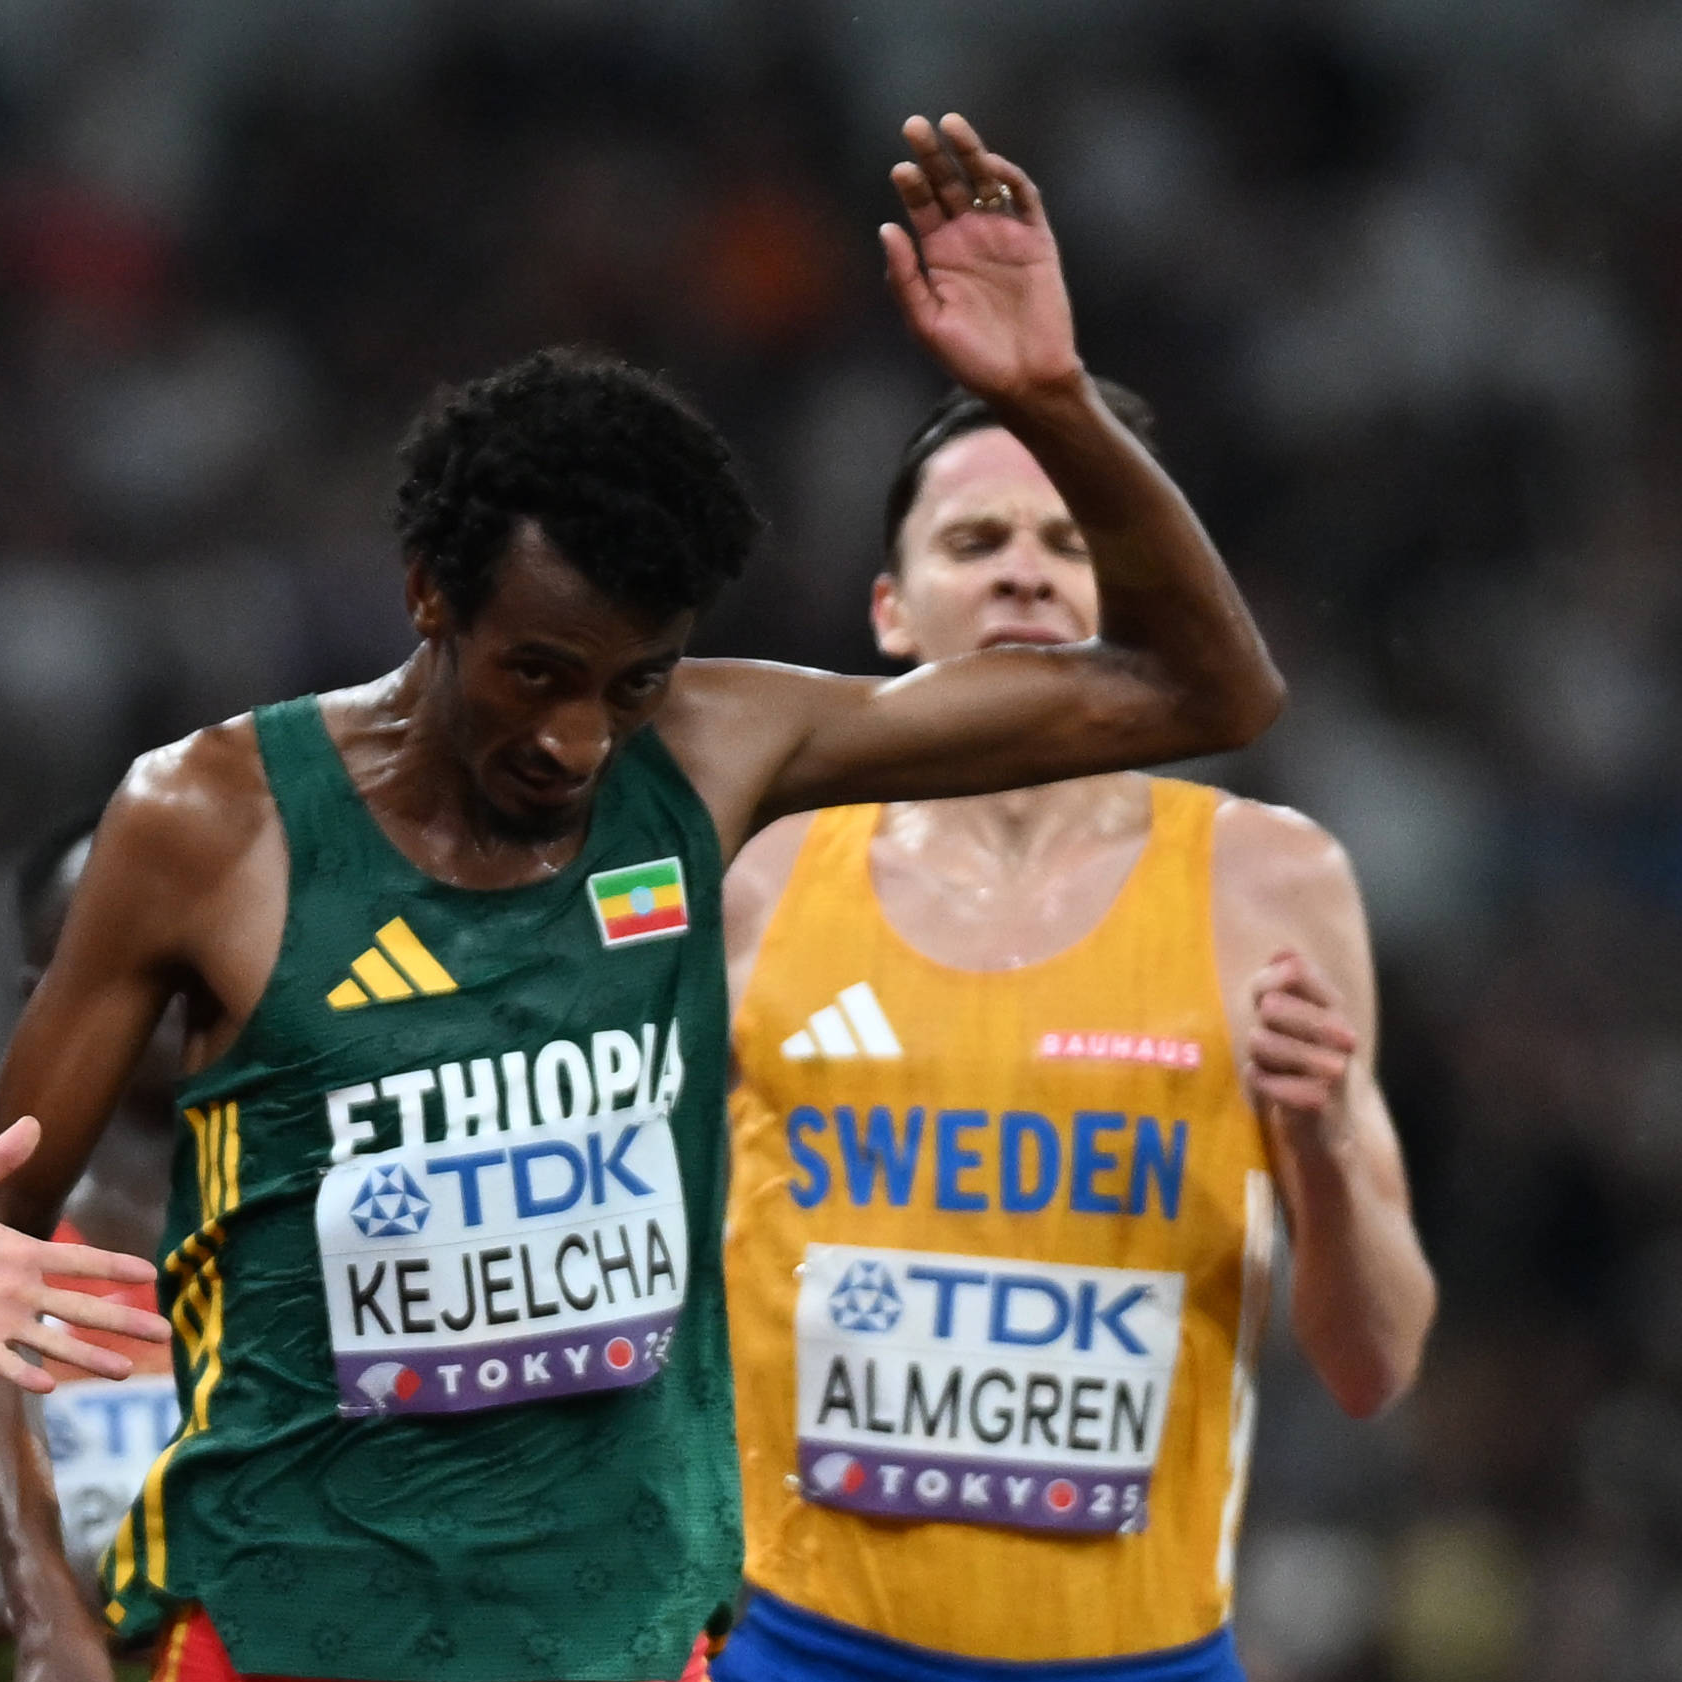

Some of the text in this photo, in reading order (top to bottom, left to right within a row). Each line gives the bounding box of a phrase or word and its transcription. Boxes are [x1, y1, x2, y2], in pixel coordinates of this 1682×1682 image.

[325, 1017, 684, 1164] ETHIOPIA
[1043, 1032, 1201, 1067] BAUHAUS
[426, 1123, 658, 1227] TDK
[785, 1104, 1190, 1220] SWEDEN
[346, 1218, 678, 1336] KEJELCHA
[906, 1264, 1153, 1357] TDK
[817, 1355, 1156, 1455] ALMGREN
